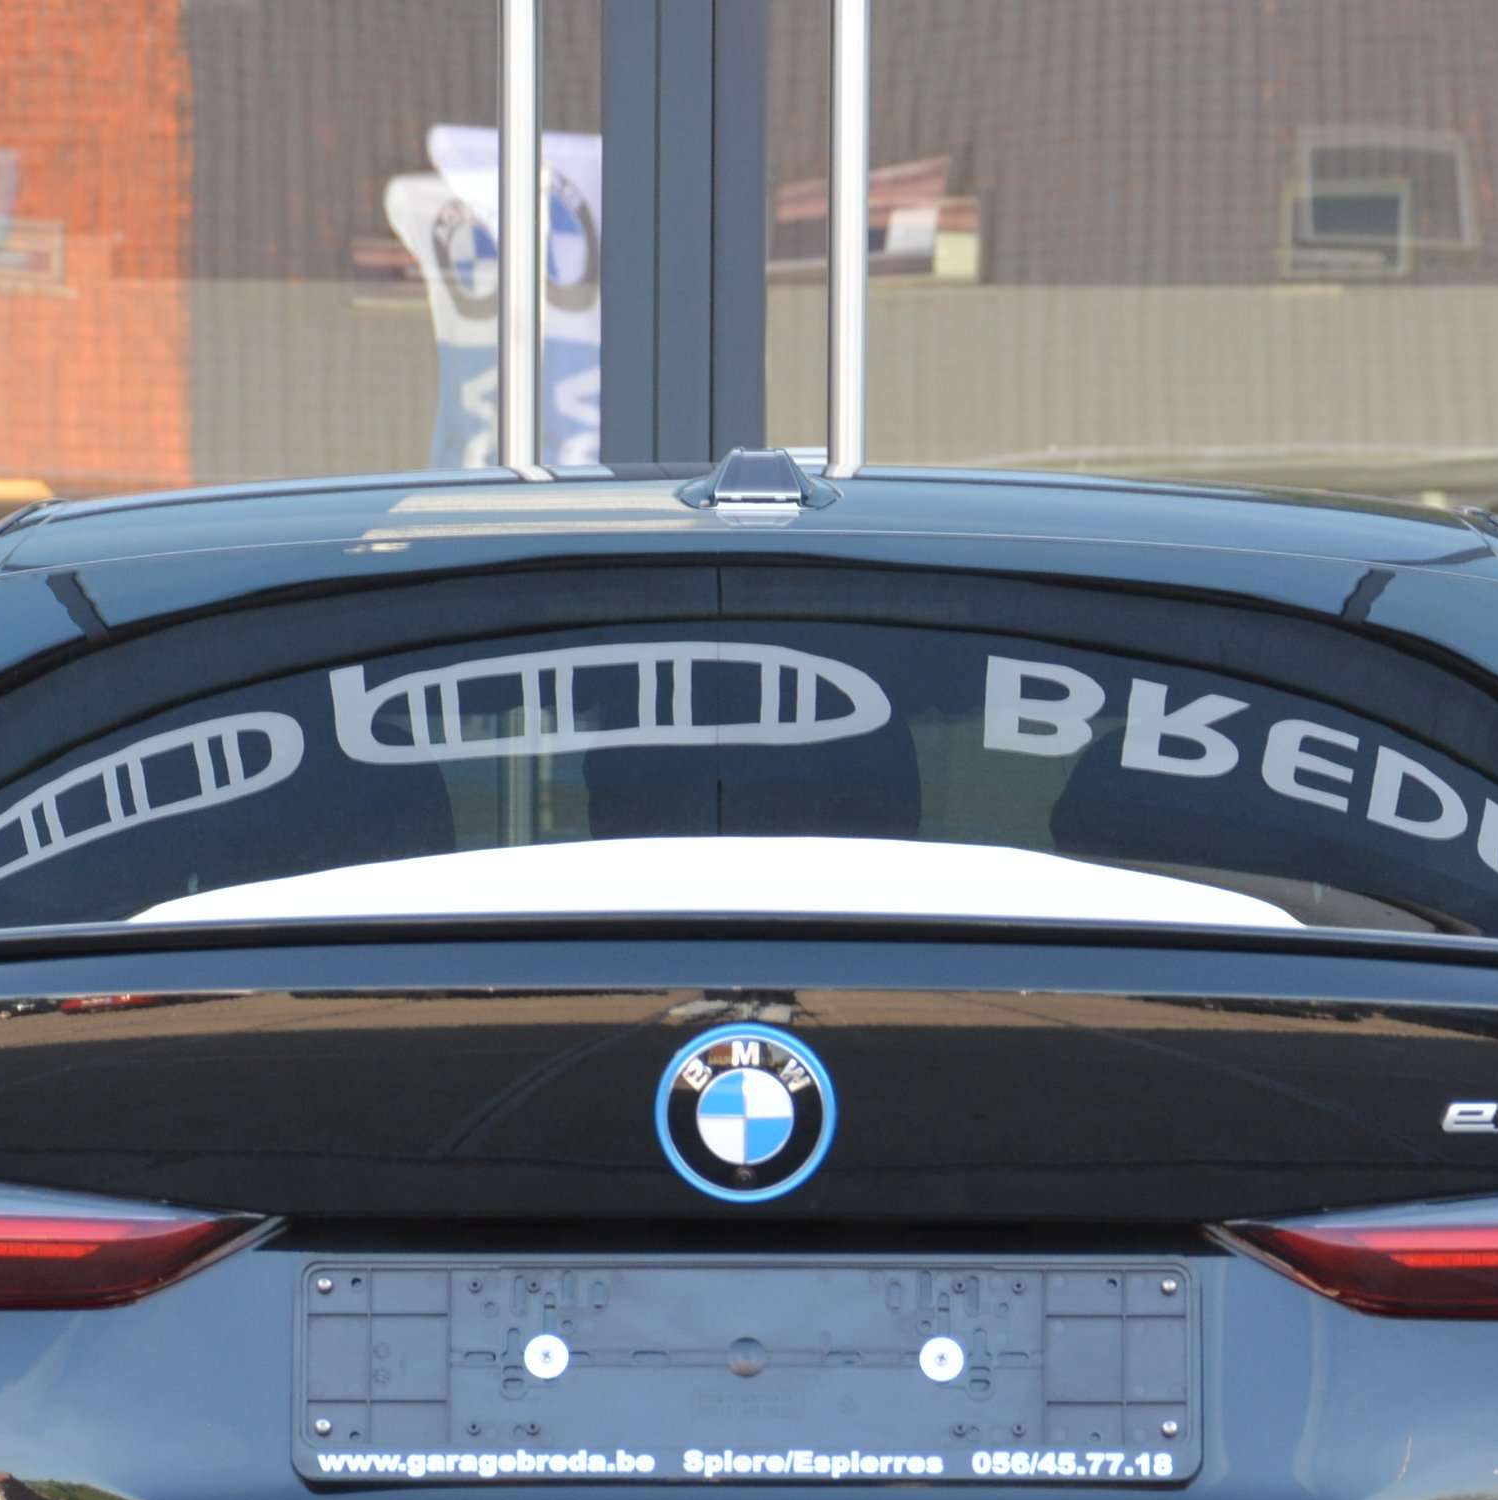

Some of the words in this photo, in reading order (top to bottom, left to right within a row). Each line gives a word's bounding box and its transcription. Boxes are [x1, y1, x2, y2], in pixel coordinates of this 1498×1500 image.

[682, 1040, 811, 1093] BMW
[317, 1449, 655, 1477] www.garagebreda.be
[683, 1449, 944, 1478] Spiere/Espierres
[972, 1451, 1173, 1476] 056/45.77.18
